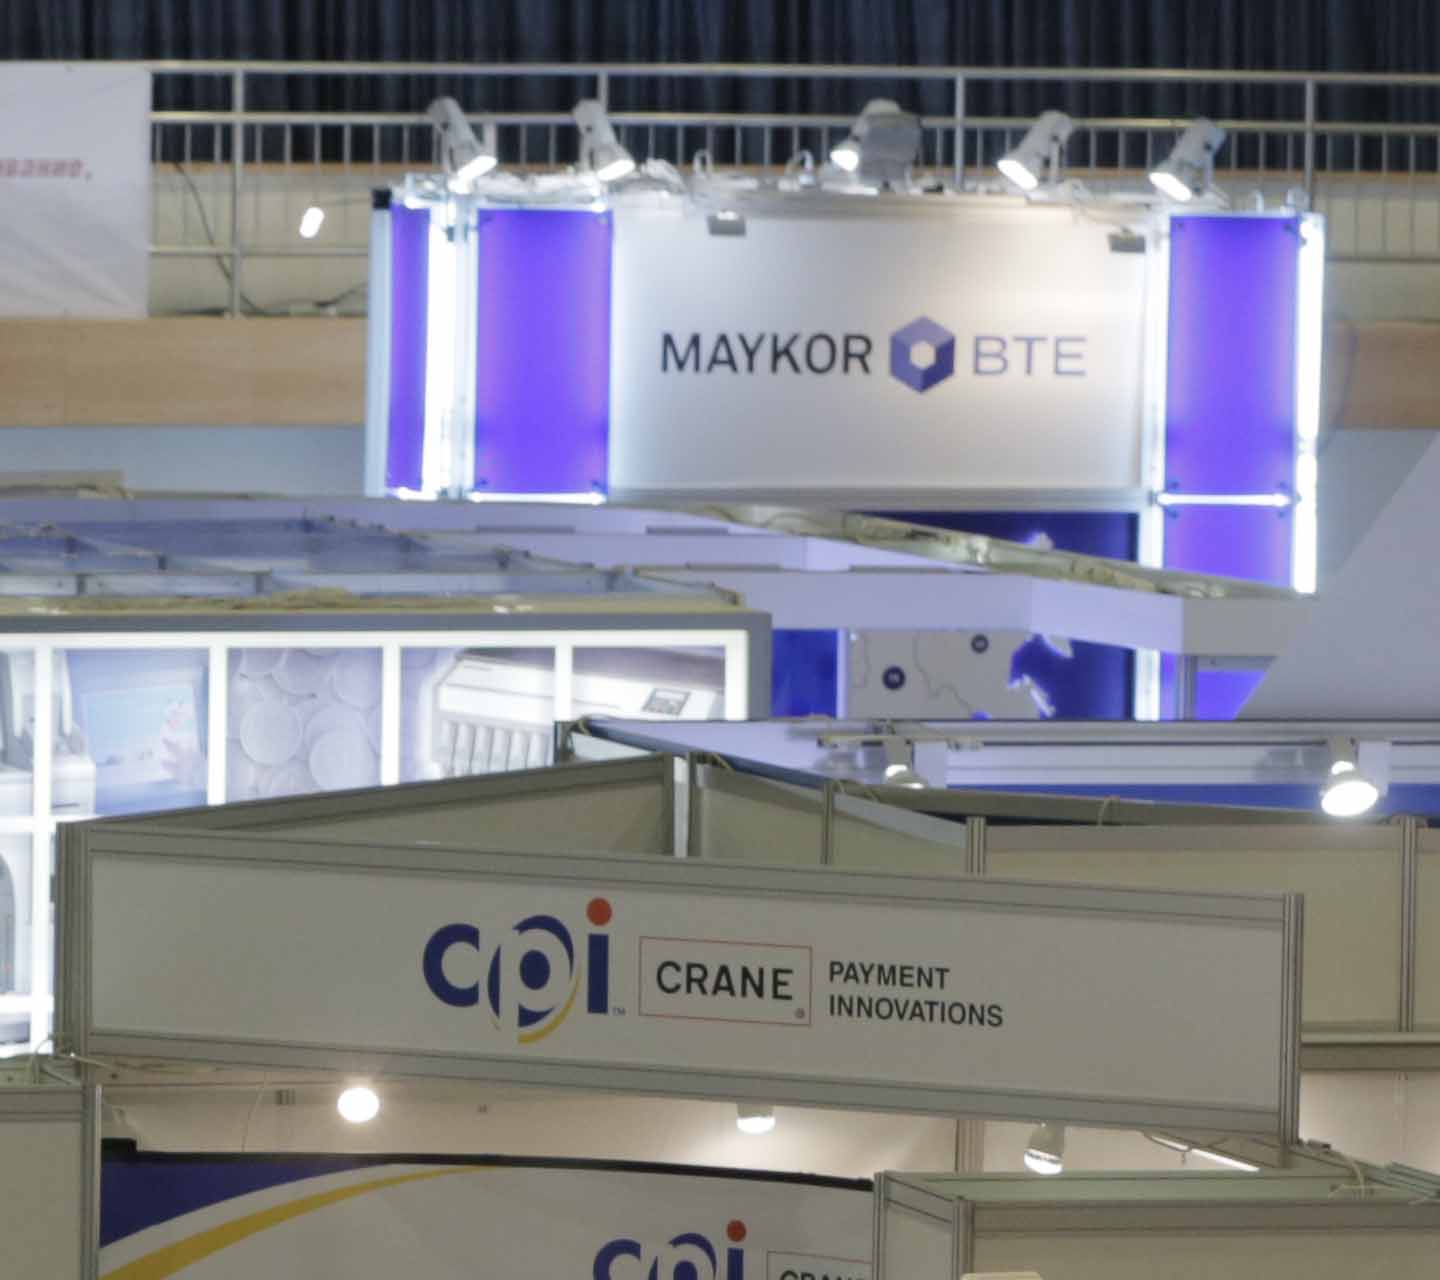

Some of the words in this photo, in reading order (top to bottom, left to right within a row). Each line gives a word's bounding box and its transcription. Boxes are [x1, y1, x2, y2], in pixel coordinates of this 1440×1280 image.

[661, 333, 873, 375] MAYKOR
[972, 336, 1087, 377] BTE
[423, 897, 613, 1044] cpi
[655, 960, 794, 1002] CRANE
[828, 960, 951, 991] PAYMENT
[828, 994, 1004, 1028] INNOVATIONS
